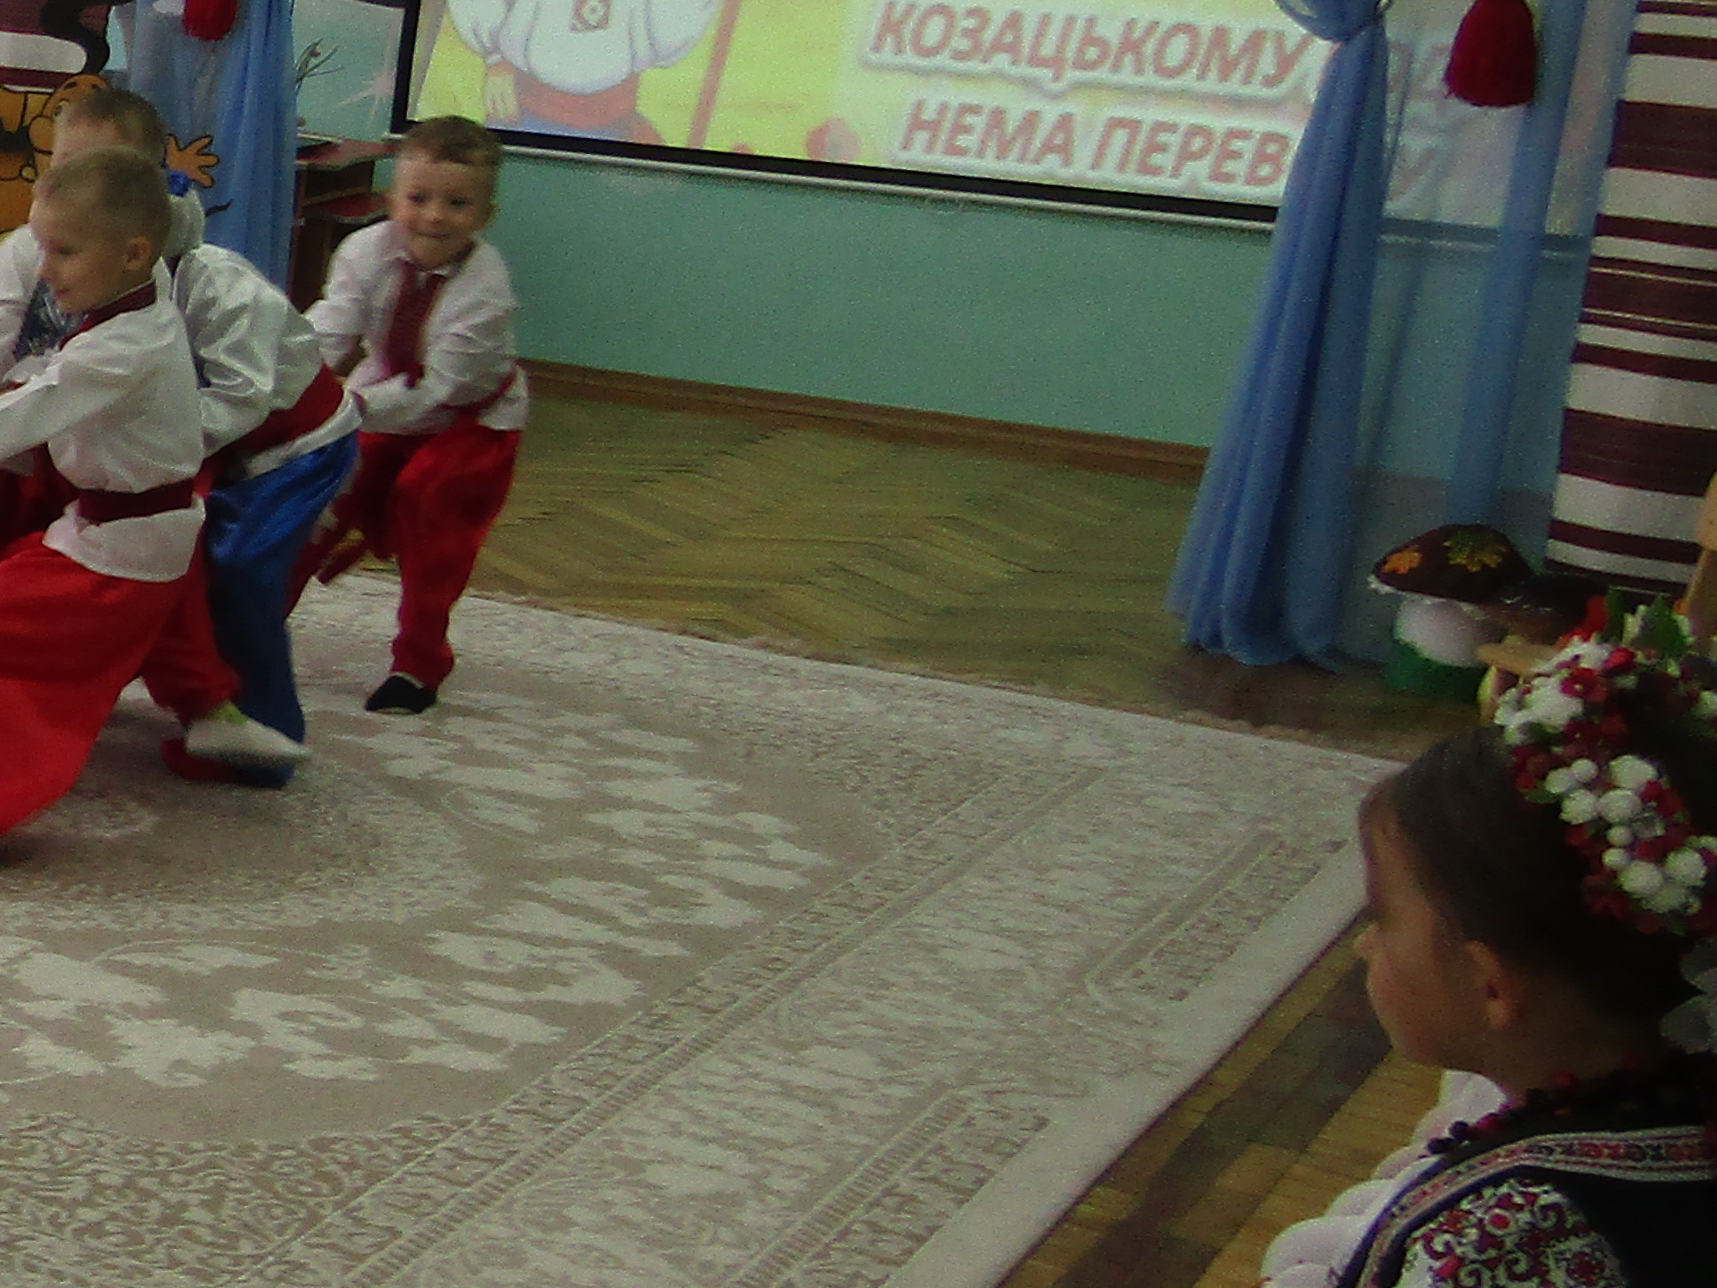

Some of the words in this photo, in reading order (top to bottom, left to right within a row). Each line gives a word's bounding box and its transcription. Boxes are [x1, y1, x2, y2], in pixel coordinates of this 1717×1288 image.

[872, 0, 1312, 88] КОЗАЦЬКОМУ
[901, 99, 1075, 170] НЕМА
[1090, 116, 1293, 187] ПЕРЕВ
